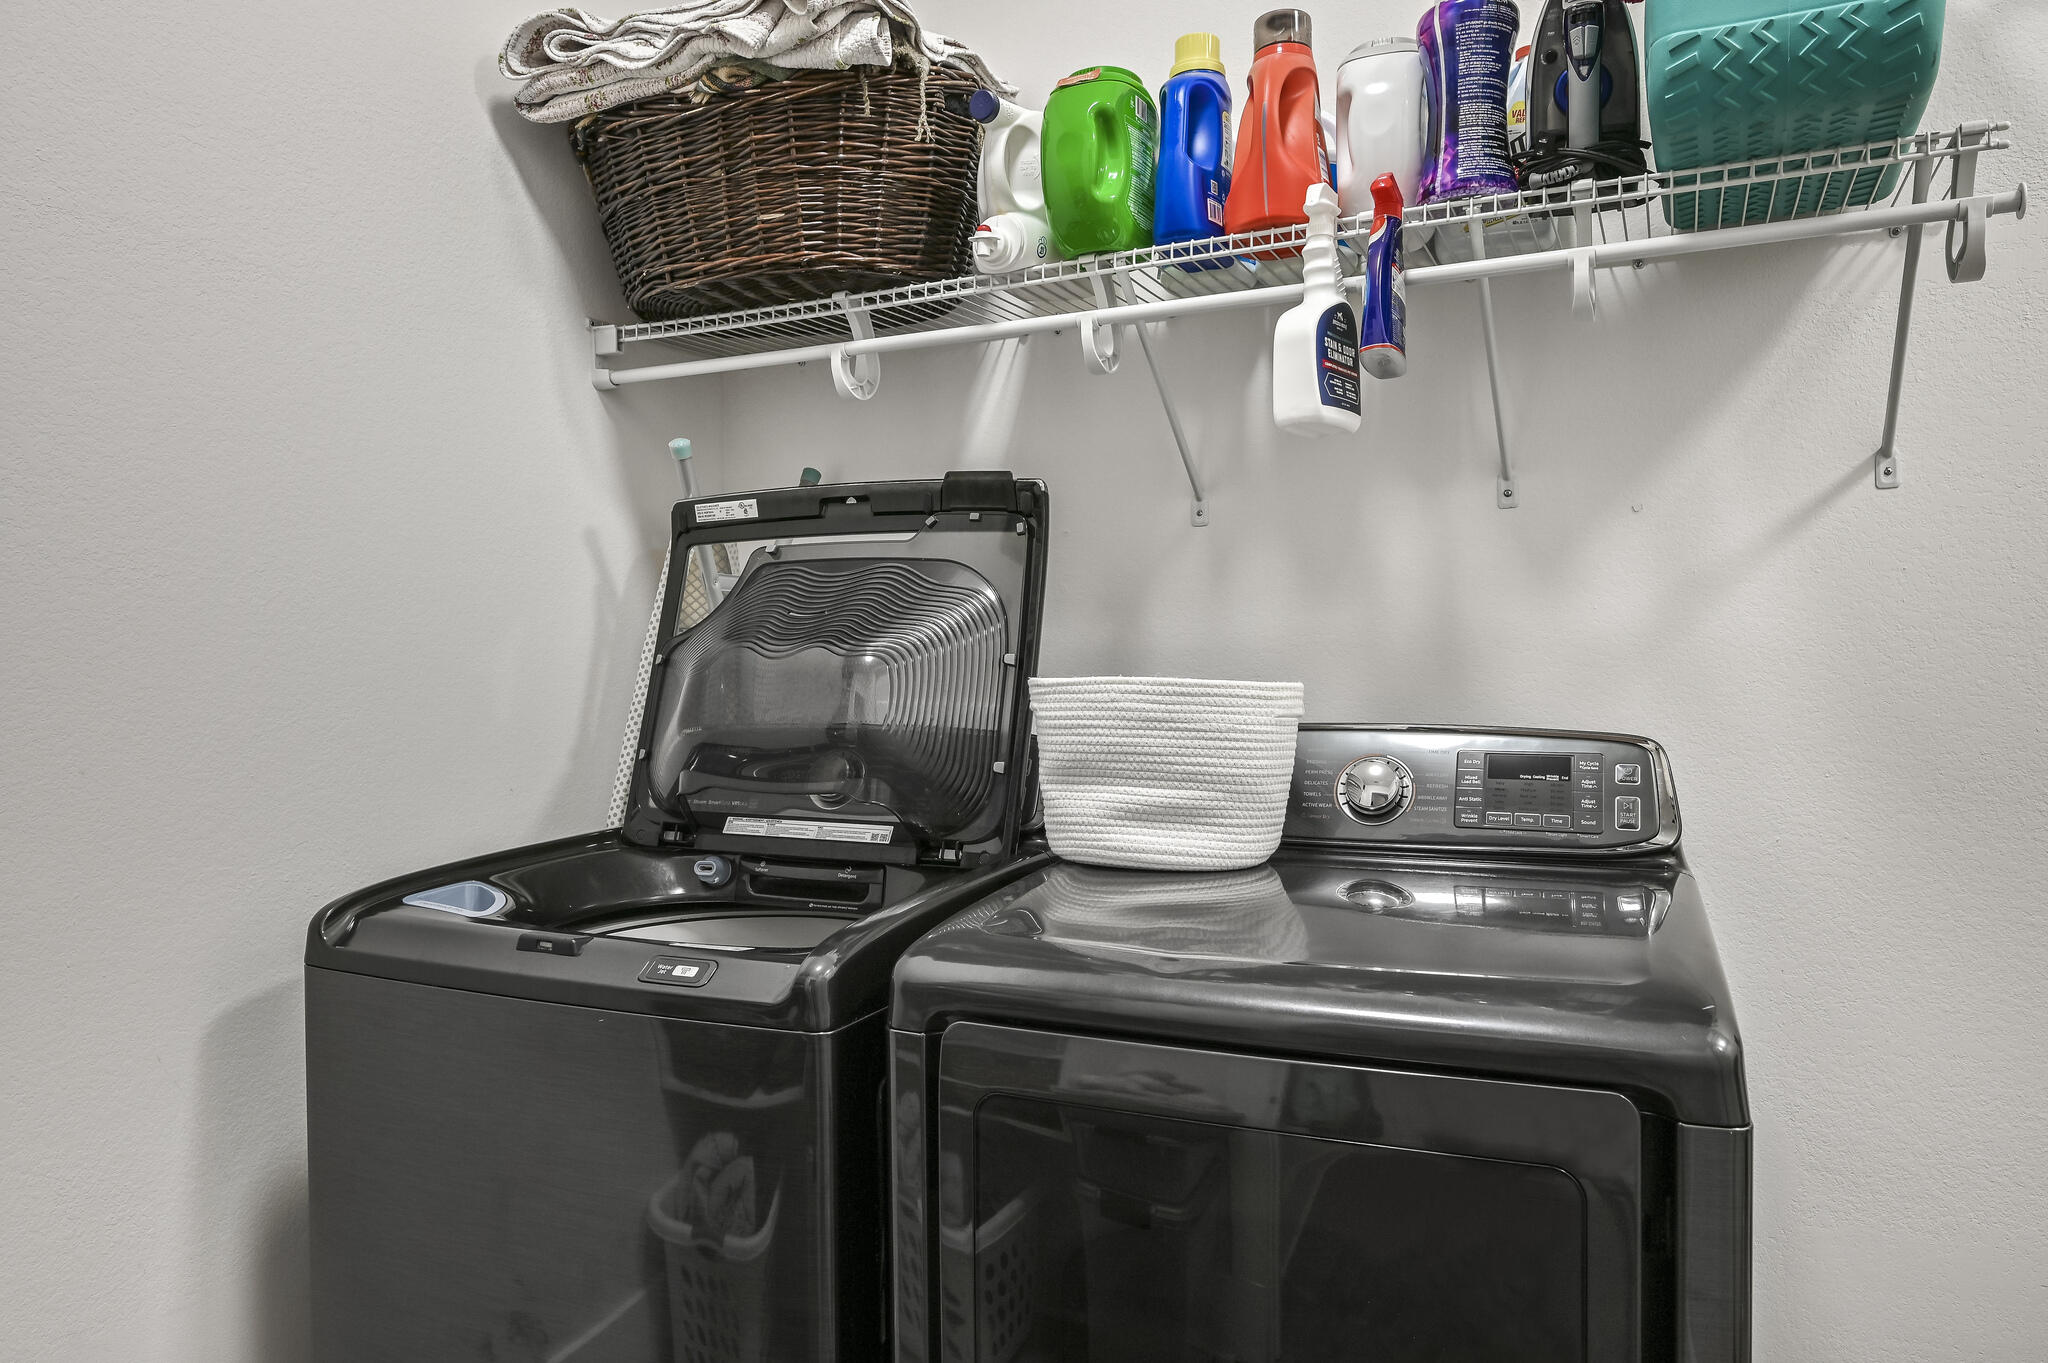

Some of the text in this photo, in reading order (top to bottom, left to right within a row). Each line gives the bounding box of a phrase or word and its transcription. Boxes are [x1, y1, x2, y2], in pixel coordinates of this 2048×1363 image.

[1324, 336, 1338, 351] STAIN
[1338, 342, 1343, 353] &
[1342, 344, 1356, 358] ODOR
[1327, 348, 1354, 367] ELIMINATOR
[837, 872, 857, 880] Detergent
